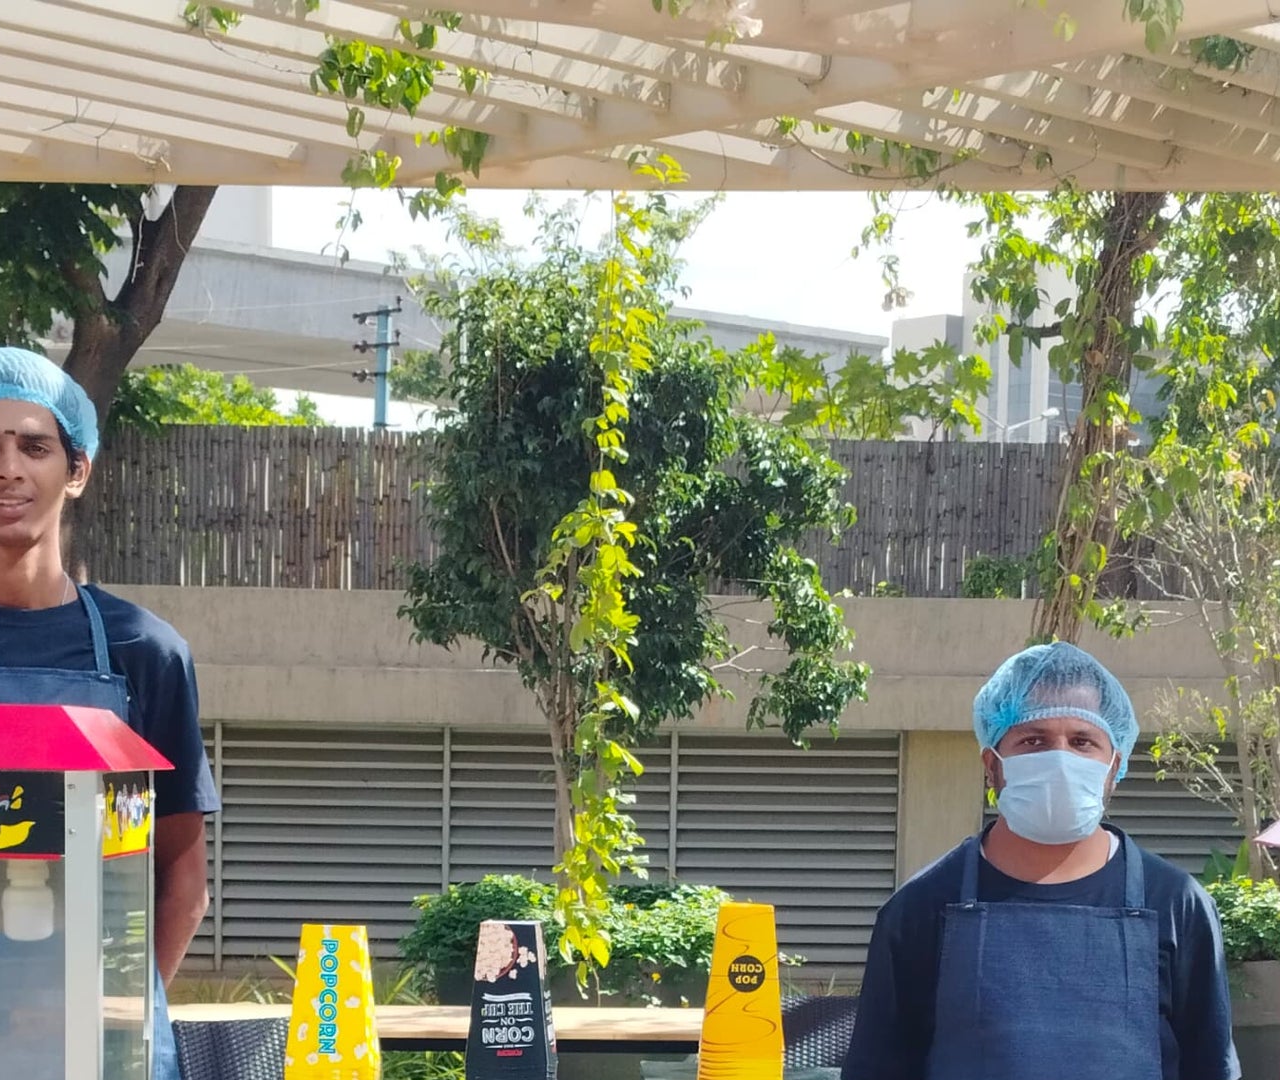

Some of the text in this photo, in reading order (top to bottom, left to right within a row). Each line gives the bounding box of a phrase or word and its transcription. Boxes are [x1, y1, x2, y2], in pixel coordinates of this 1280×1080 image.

[735, 975, 759, 985] POP
[318, 939, 339, 1054] POPCORN
[481, 1002, 534, 1017] THE CUP
[500, 1017, 516, 1026] ON
[481, 1026, 535, 1044] CORN
